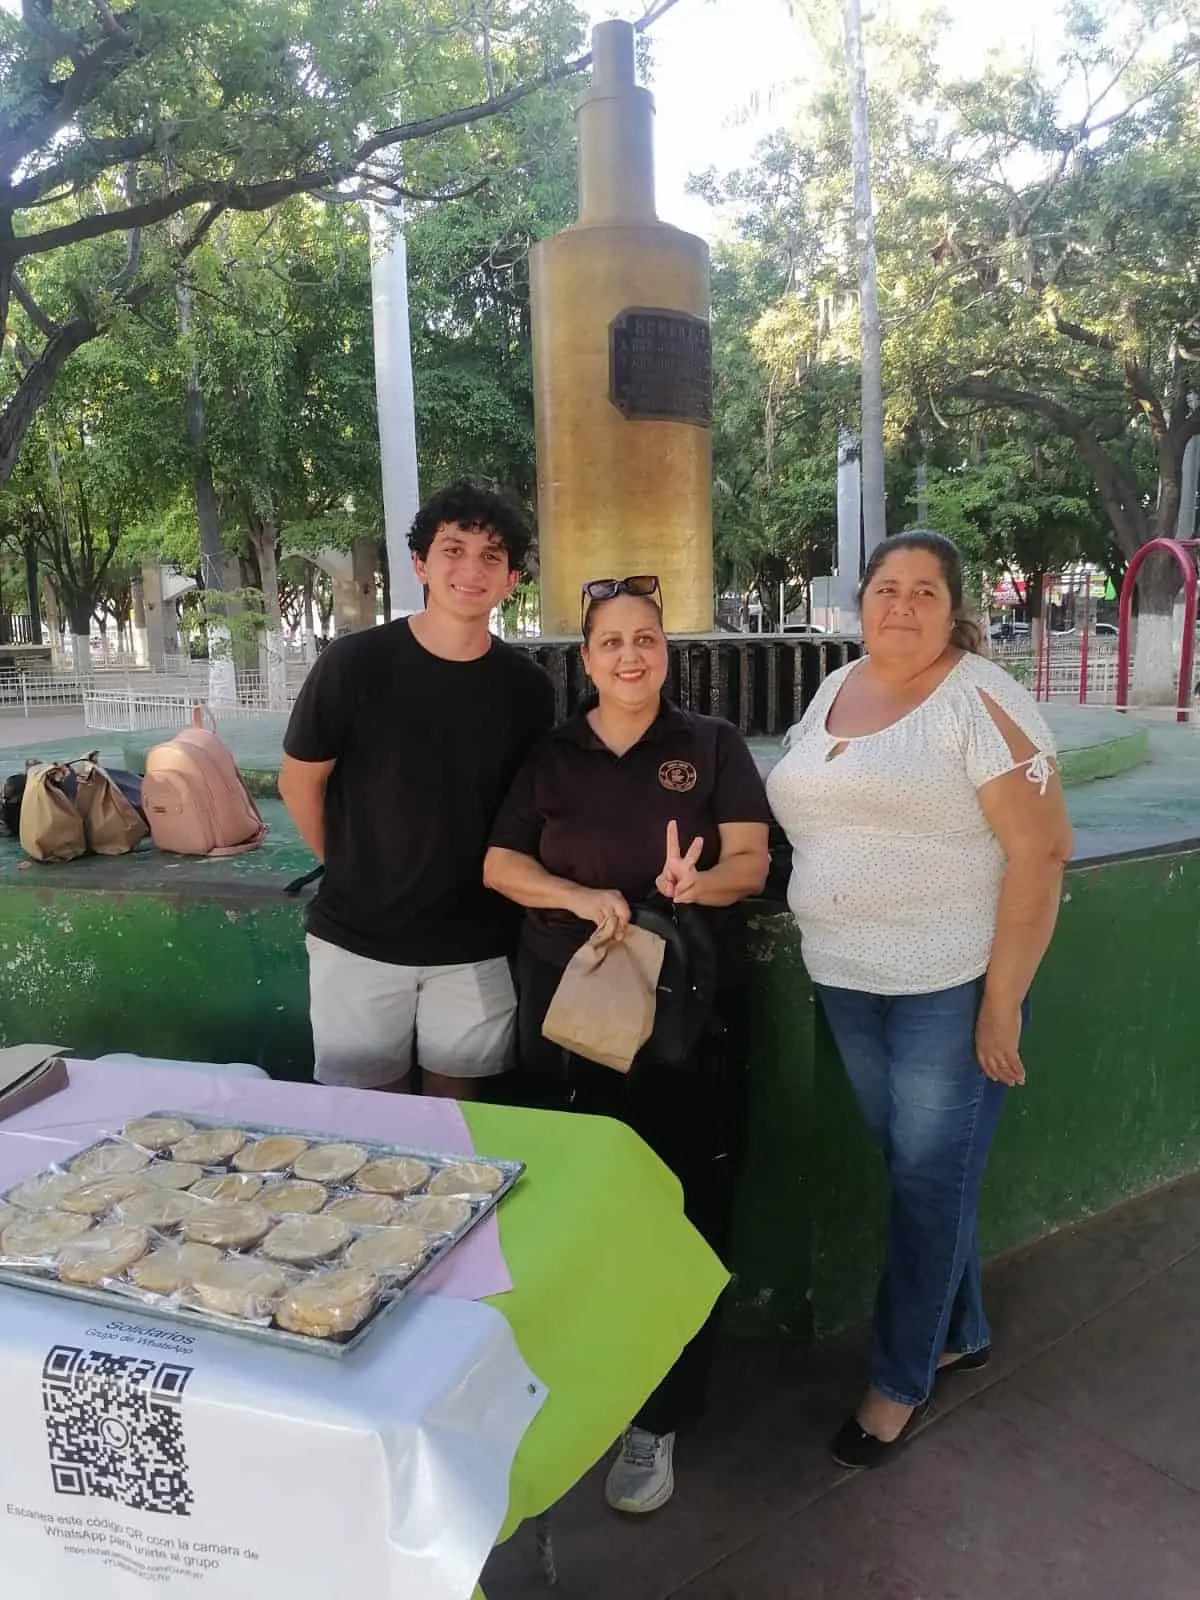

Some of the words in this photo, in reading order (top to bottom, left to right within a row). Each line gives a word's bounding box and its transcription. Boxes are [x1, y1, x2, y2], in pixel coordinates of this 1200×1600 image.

[85, 1328, 119, 1343] Grupo
[120, 1333, 135, 1343] de
[137, 1337, 194, 1355] WhatsApp
[106, 1321, 196, 1344] Solidarios
[6, 1503, 54, 1524] Escanea
[57, 1515, 82, 1527] este
[125, 1525, 143, 1540] QR
[146, 1535, 174, 1548] ccon
[178, 1537, 190, 1550] la
[243, 1547, 259, 1560] de
[45, 1525, 105, 1543] WhatsApp
[109, 1533, 132, 1549] para
[184, 1552, 220, 1569] grupo
